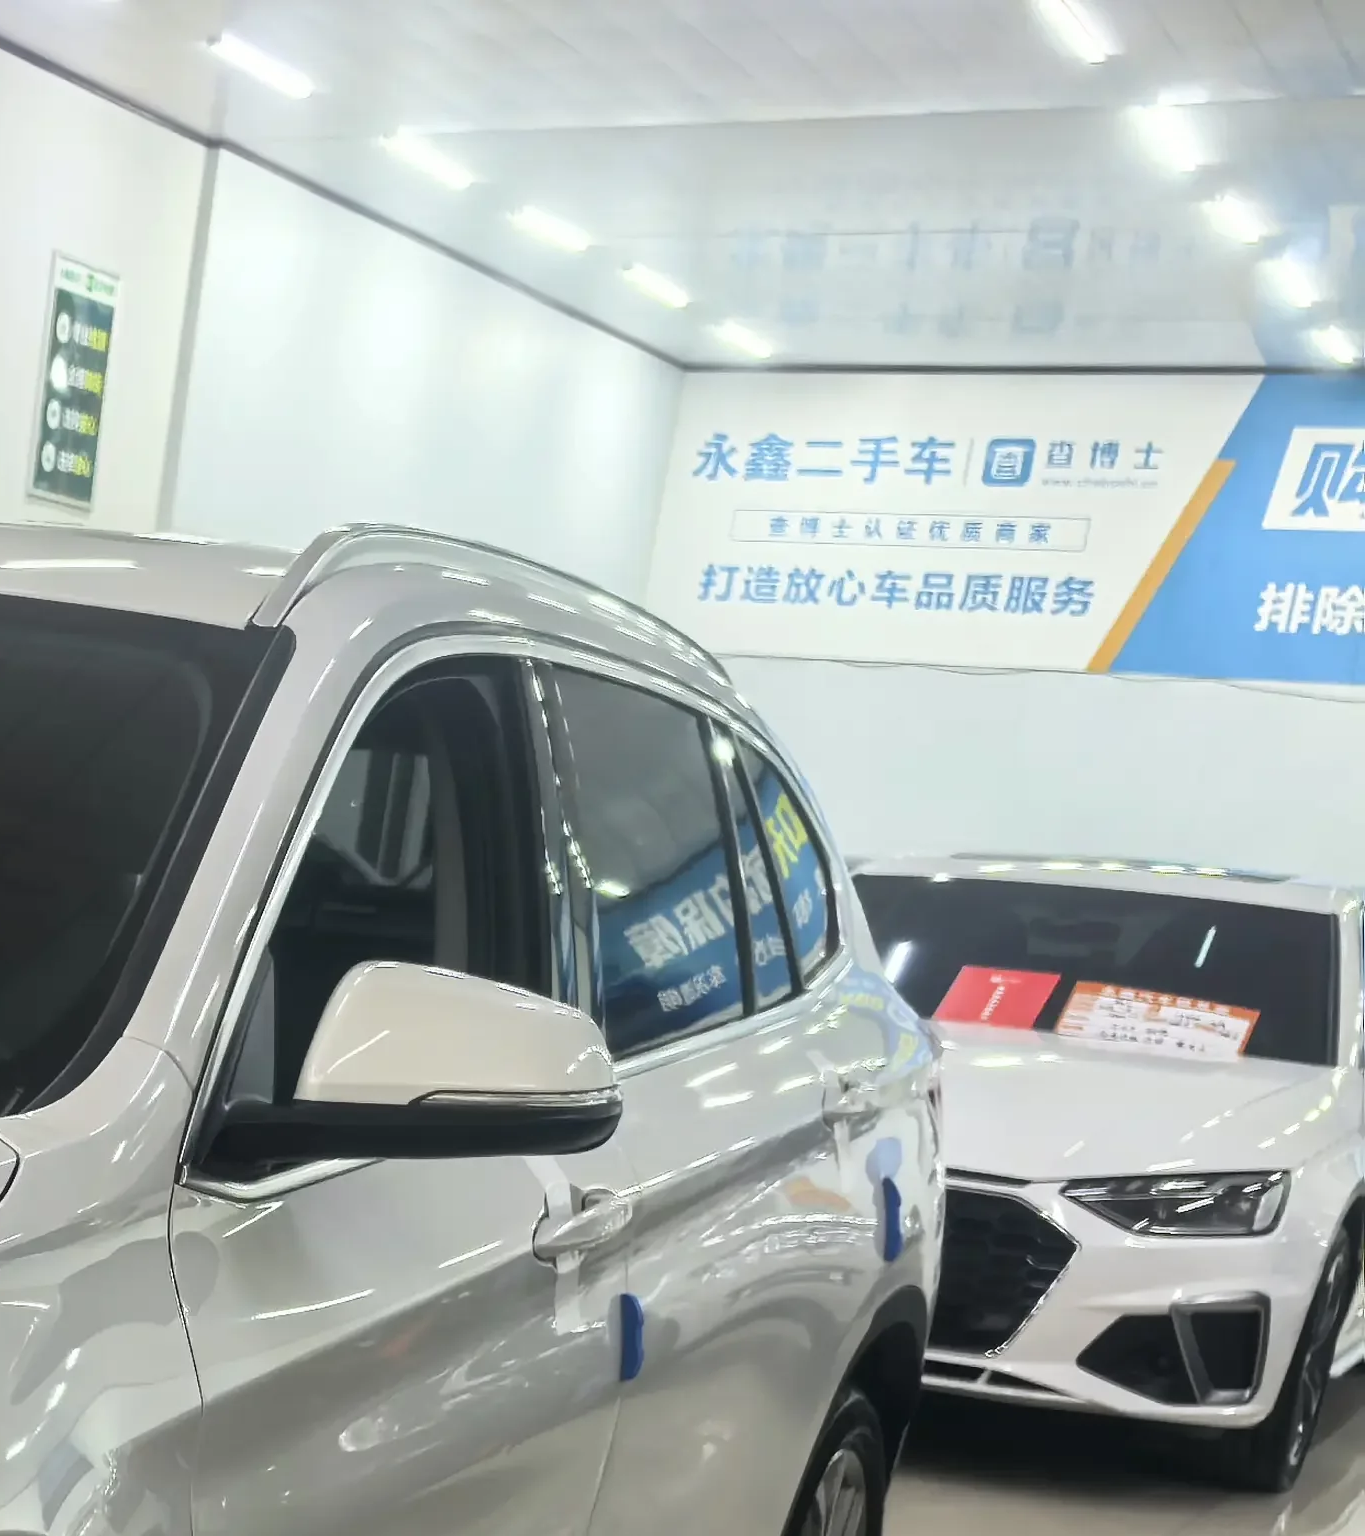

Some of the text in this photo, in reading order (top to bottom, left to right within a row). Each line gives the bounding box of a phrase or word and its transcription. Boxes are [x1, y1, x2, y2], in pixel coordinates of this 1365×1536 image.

[691, 432, 957, 486] 永鑫二手车
[697, 562, 1095, 618] 打造放心车品质服务
